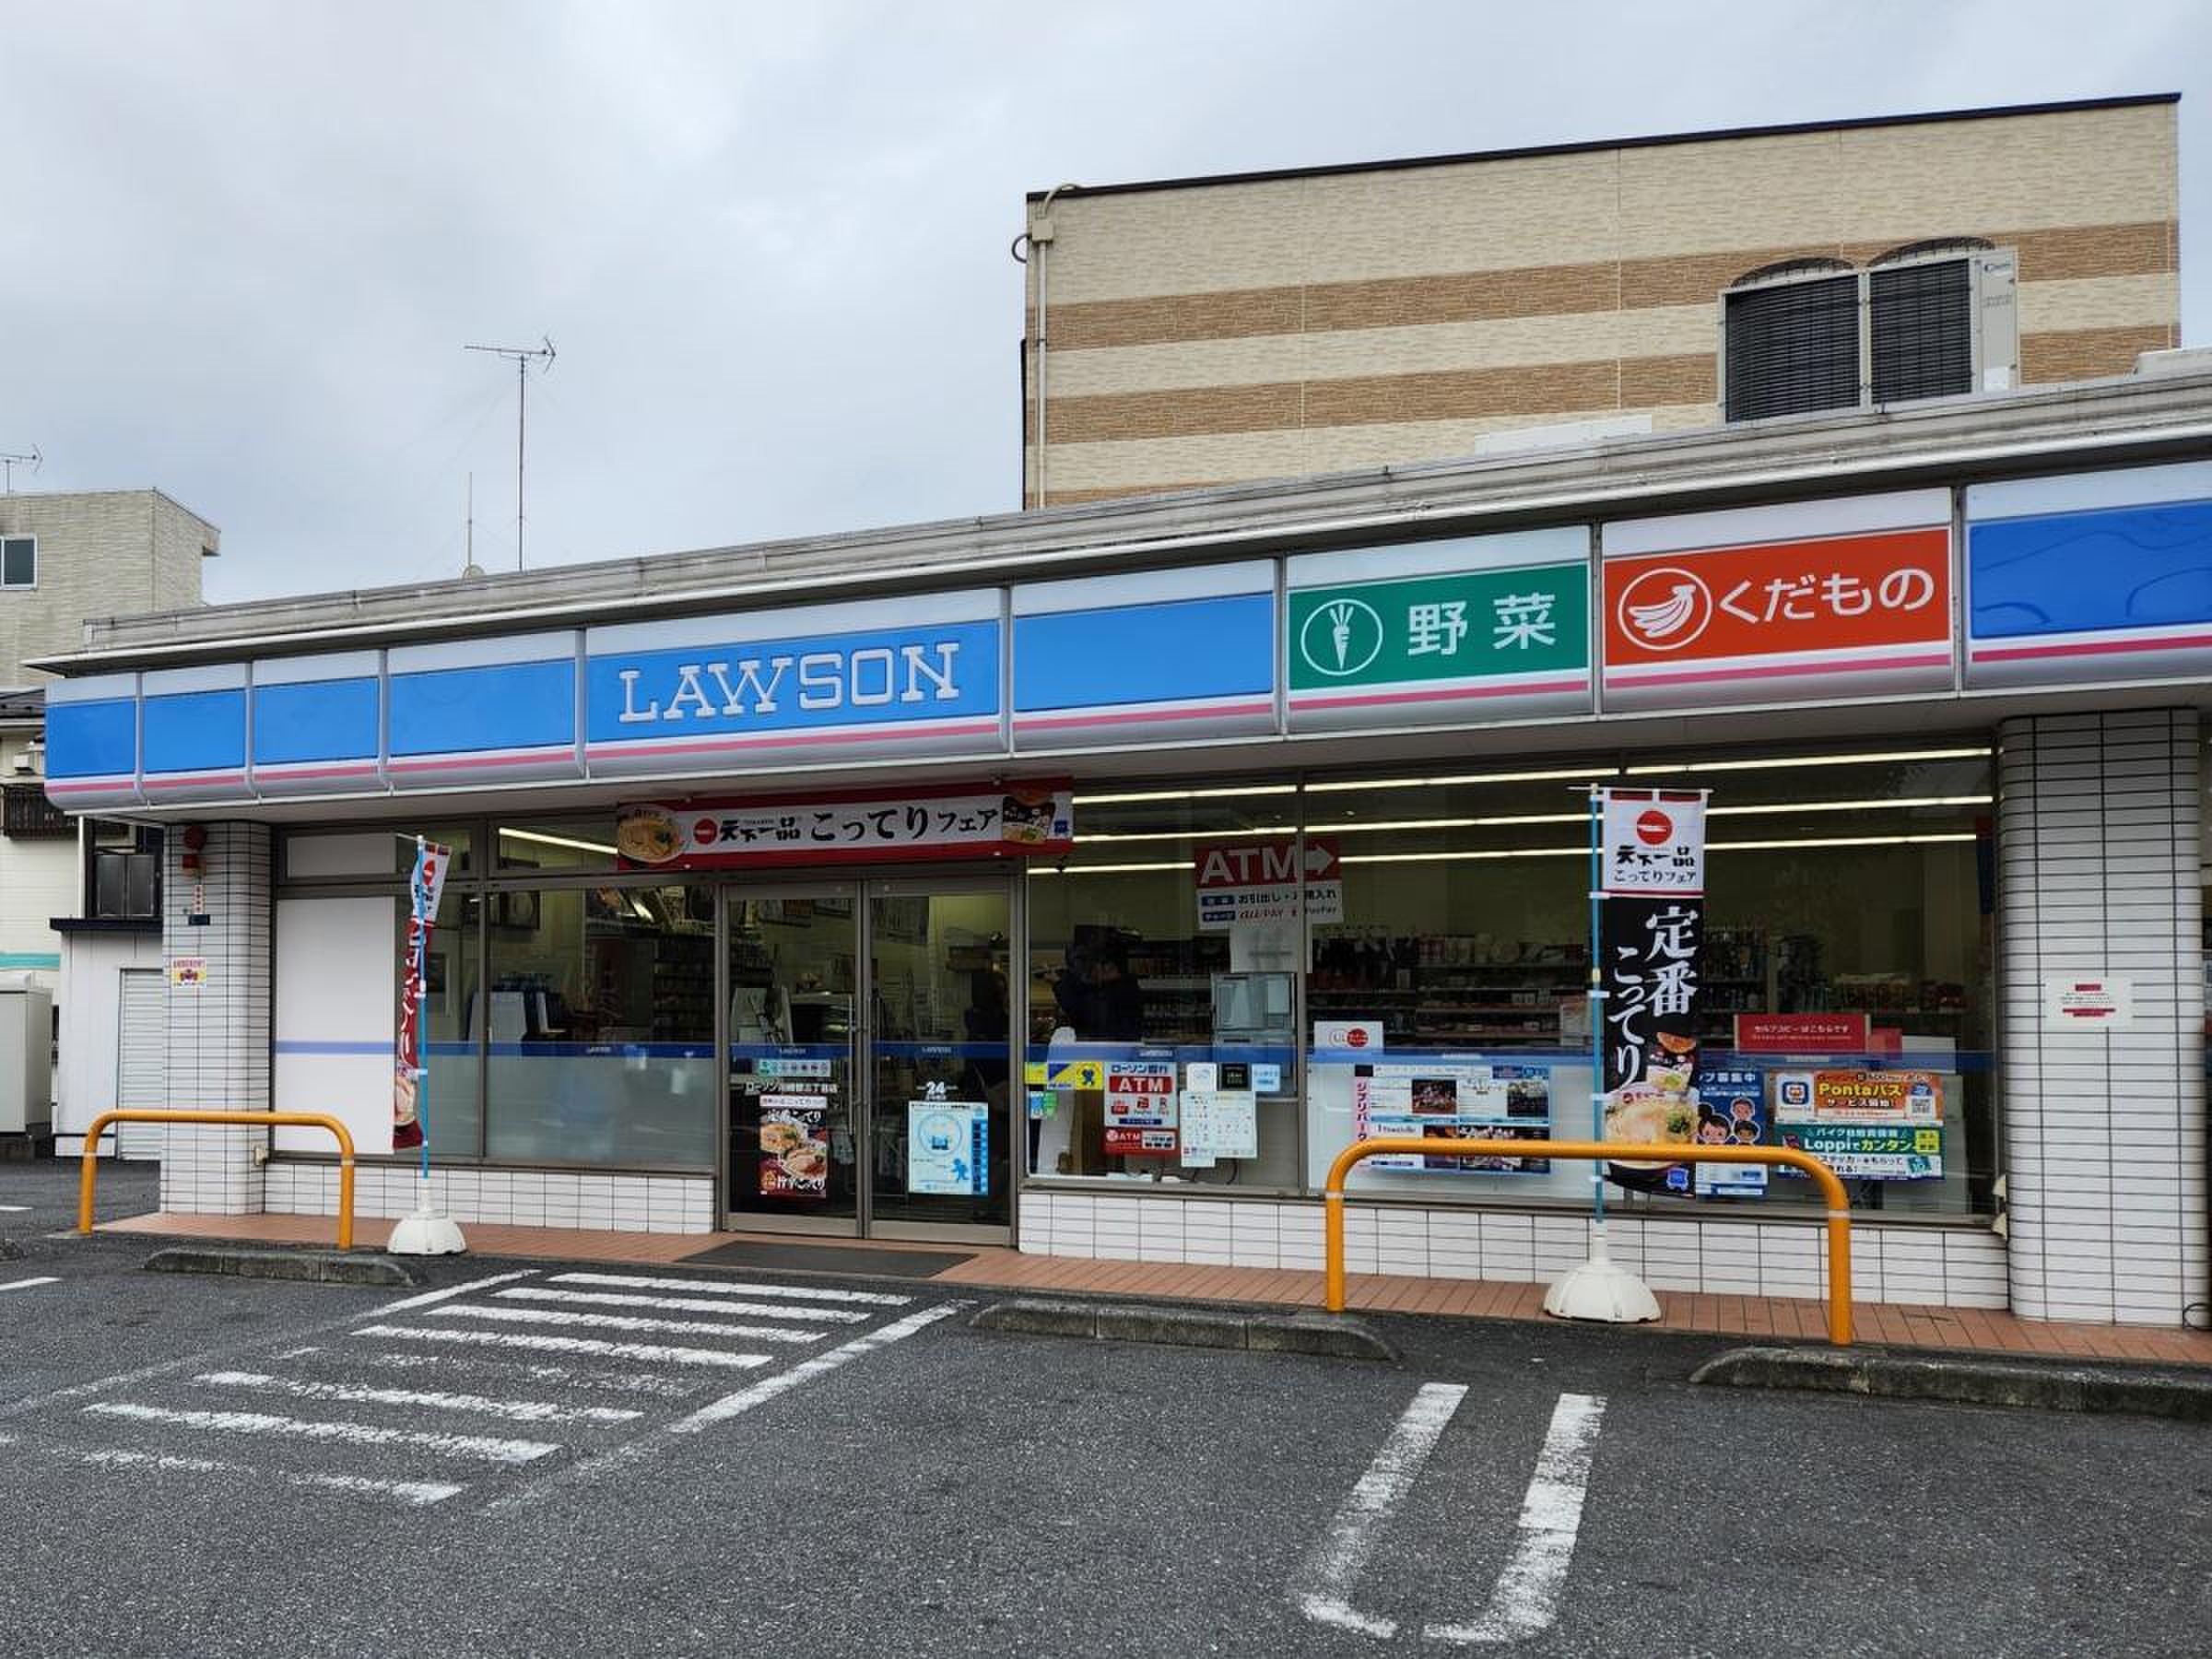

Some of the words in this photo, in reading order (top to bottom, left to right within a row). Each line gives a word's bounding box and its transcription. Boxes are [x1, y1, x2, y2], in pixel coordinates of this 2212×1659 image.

[1718, 567, 1935, 625] くだもの
[1407, 591, 1557, 656] 野菜
[618, 641, 960, 724] LAWSON
[720, 816, 801, 842] 天下一品
[811, 806, 999, 841] こってりフェア
[1200, 844, 1300, 885] ATM
[1617, 844, 1695, 867] 天下一品
[1614, 869, 1697, 883] こってりフェア
[1643, 905, 1699, 1017] 定番
[1607, 945, 1646, 1091] こってり
[926, 1081, 946, 1093] 24
[1119, 1077, 1164, 1092] ATM
[1818, 1082, 1903, 1097] Pontaパス
